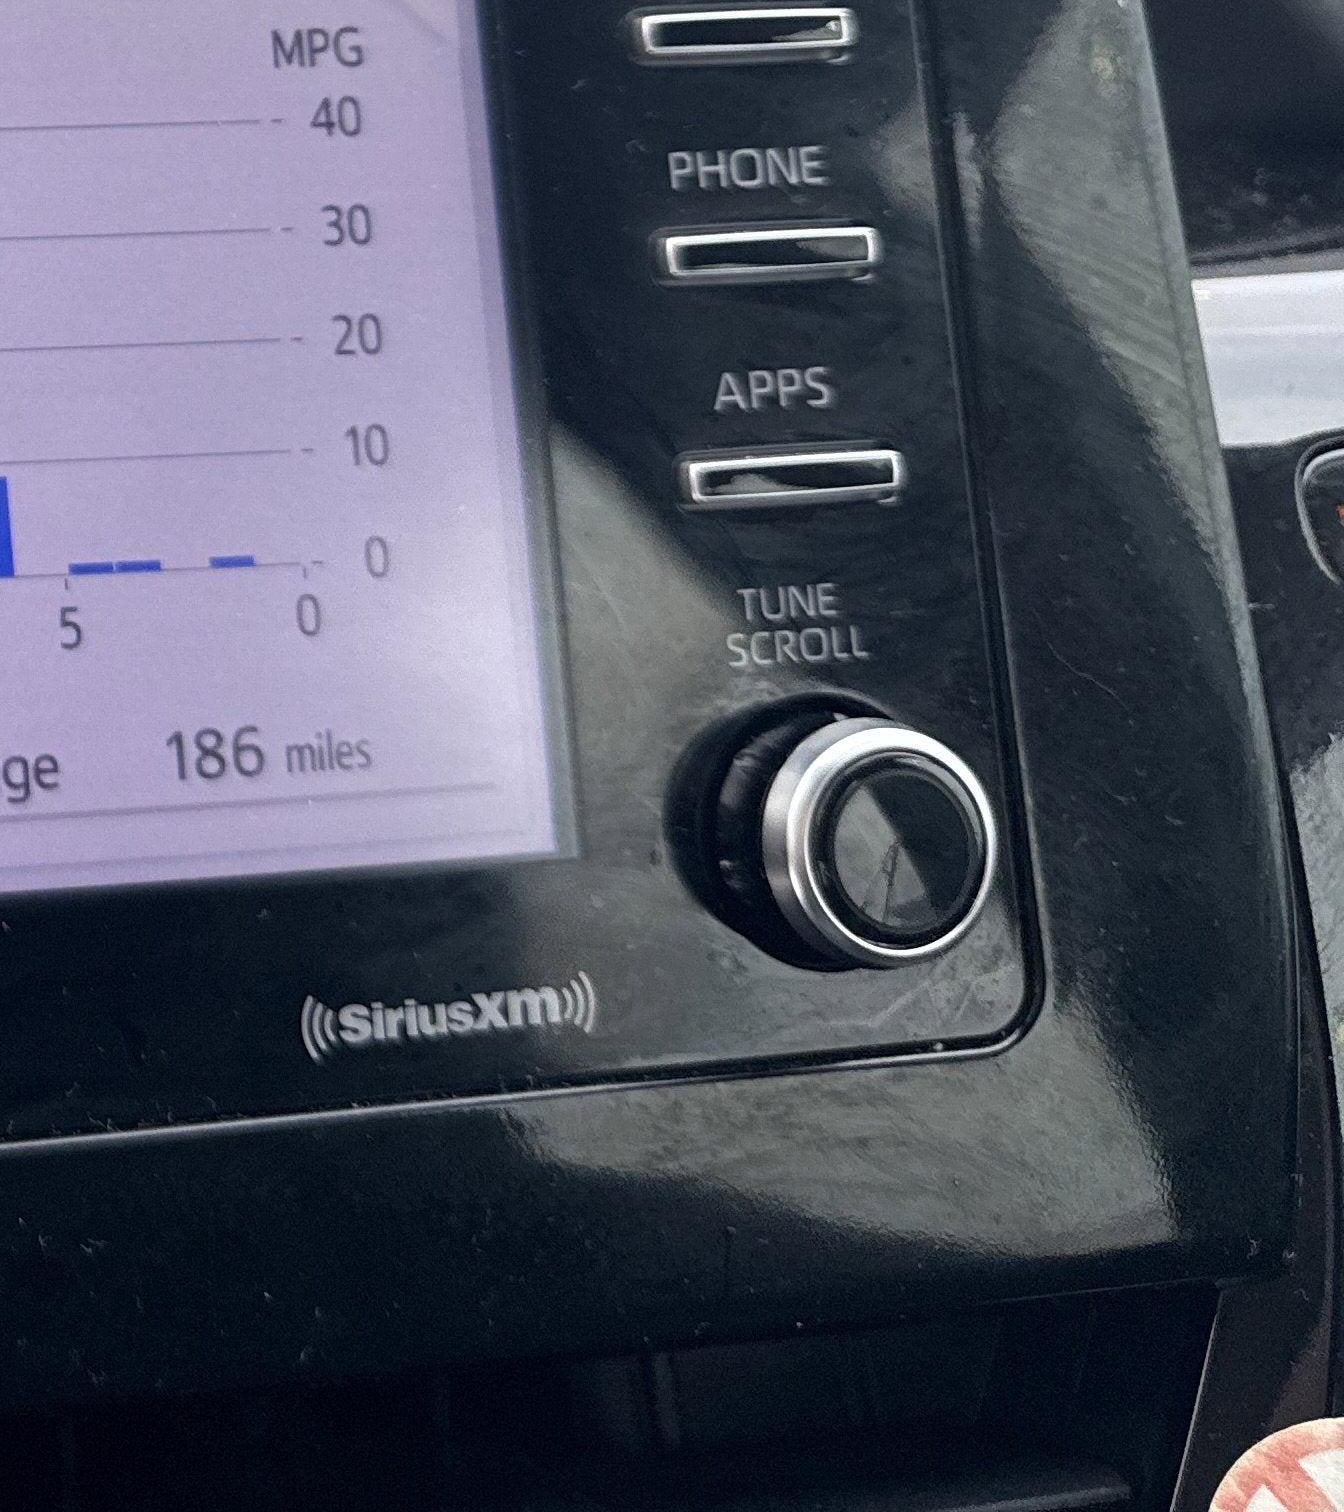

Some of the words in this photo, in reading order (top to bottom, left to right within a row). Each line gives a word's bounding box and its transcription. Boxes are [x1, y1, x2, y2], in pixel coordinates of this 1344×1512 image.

[271, 26, 365, 69] MPG
[310, 95, 362, 138] 40
[668, 145, 826, 189] PHONE
[321, 203, 373, 247] 30
[332, 313, 383, 356] 20
[714, 366, 832, 411] APPS
[345, 423, 390, 467] 10
[364, 535, 391, 579] 0
[295, 593, 322, 638] 0
[736, 583, 840, 622] TUNE
[59, 606, 83, 651] 5
[726, 625, 870, 668] SCROLL
[166, 725, 266, 781] 186
[285, 729, 373, 774] miles
